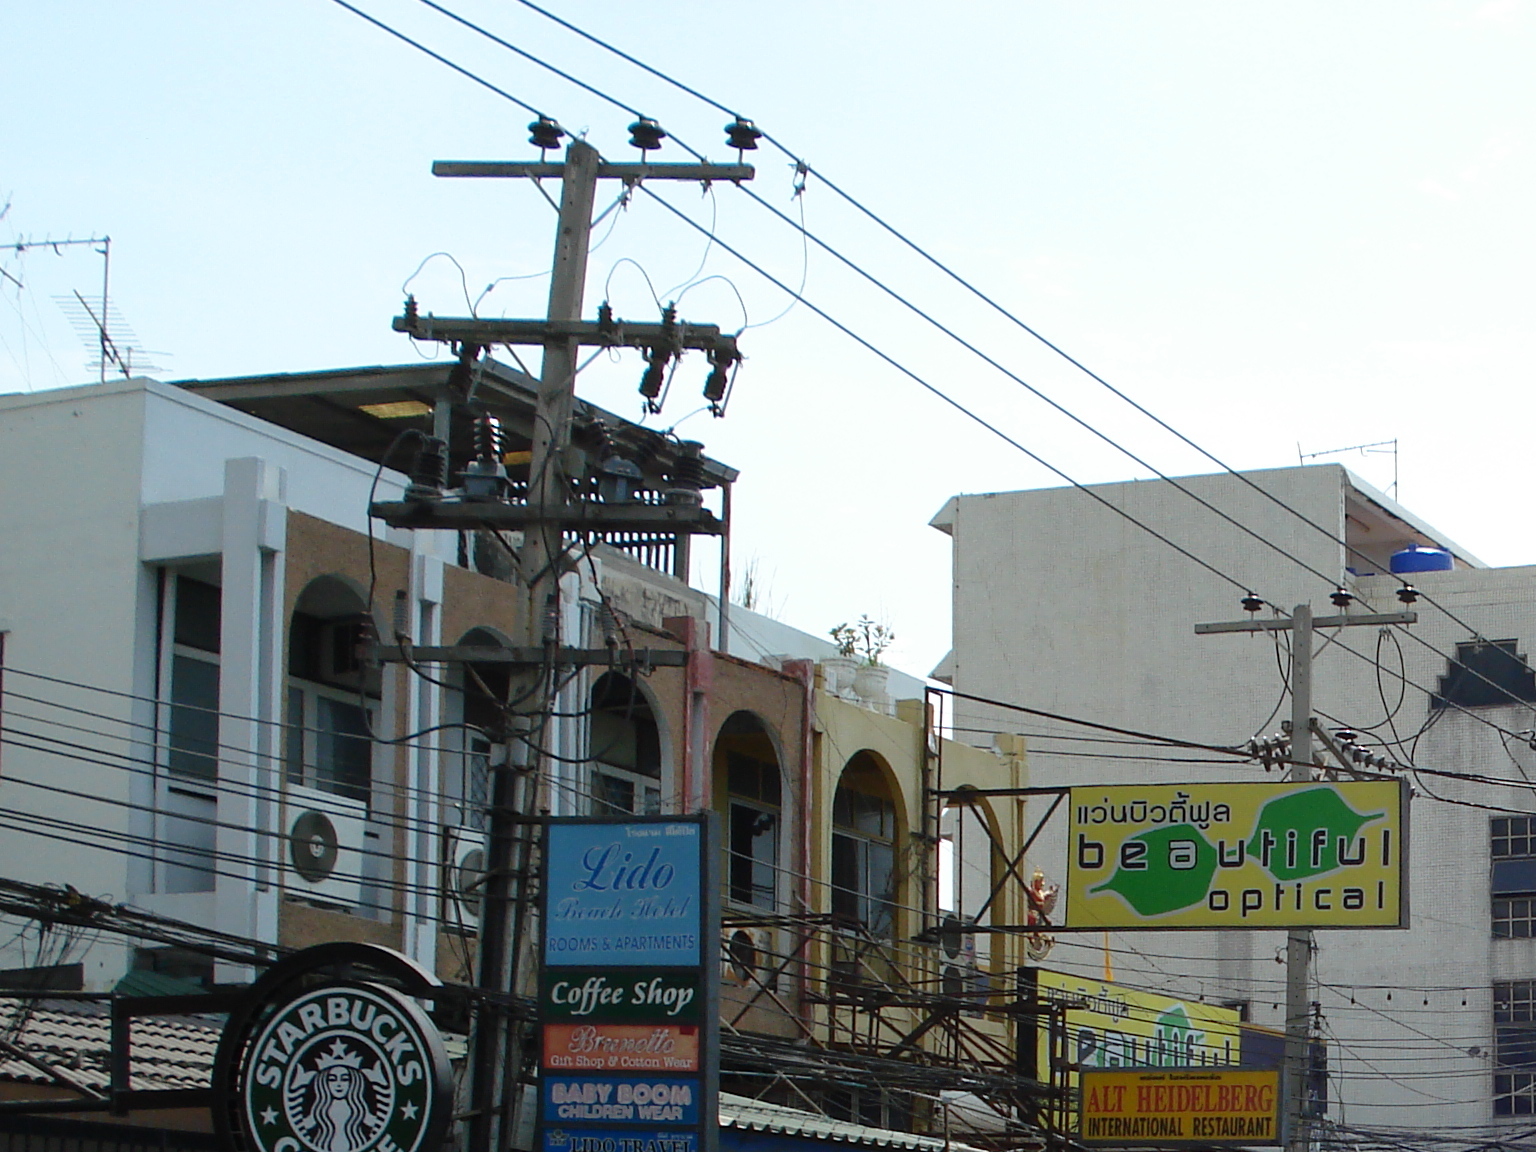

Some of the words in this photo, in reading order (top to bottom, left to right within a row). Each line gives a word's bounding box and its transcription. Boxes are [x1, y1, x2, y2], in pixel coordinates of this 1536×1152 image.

[1077, 791, 1230, 829] แว่นบิวตี้ฟูล
[1077, 829, 1390, 869] beautiful
[573, 842, 674, 892] Lido
[555, 897, 622, 921] Beach
[631, 895, 691, 920] Hotel
[1208, 880, 1385, 918] optical
[549, 936, 598, 952] ROOMS
[602, 936, 611, 950] &
[615, 934, 695, 950] APARTMENTS
[551, 976, 624, 1015] Coffee
[631, 977, 695, 1016] Shop
[256, 997, 422, 1090] STARBUCKS
[550, 1055, 572, 1067] Gift
[576, 1057, 605, 1071] Shop
[620, 1057, 660, 1068] Cotton
[663, 1058, 693, 1069] Wear
[551, 1082, 612, 1104] BABY
[617, 1083, 692, 1106] BOOM
[1087, 1085, 1127, 1114] ALT
[1136, 1084, 1273, 1114] HEIDELBERG
[557, 1104, 634, 1120] CHILDREN
[637, 1106, 684, 1121] WEAR
[1088, 1118, 1184, 1138] INTERNATIONAL
[1193, 1117, 1273, 1138] RESTAURANT
